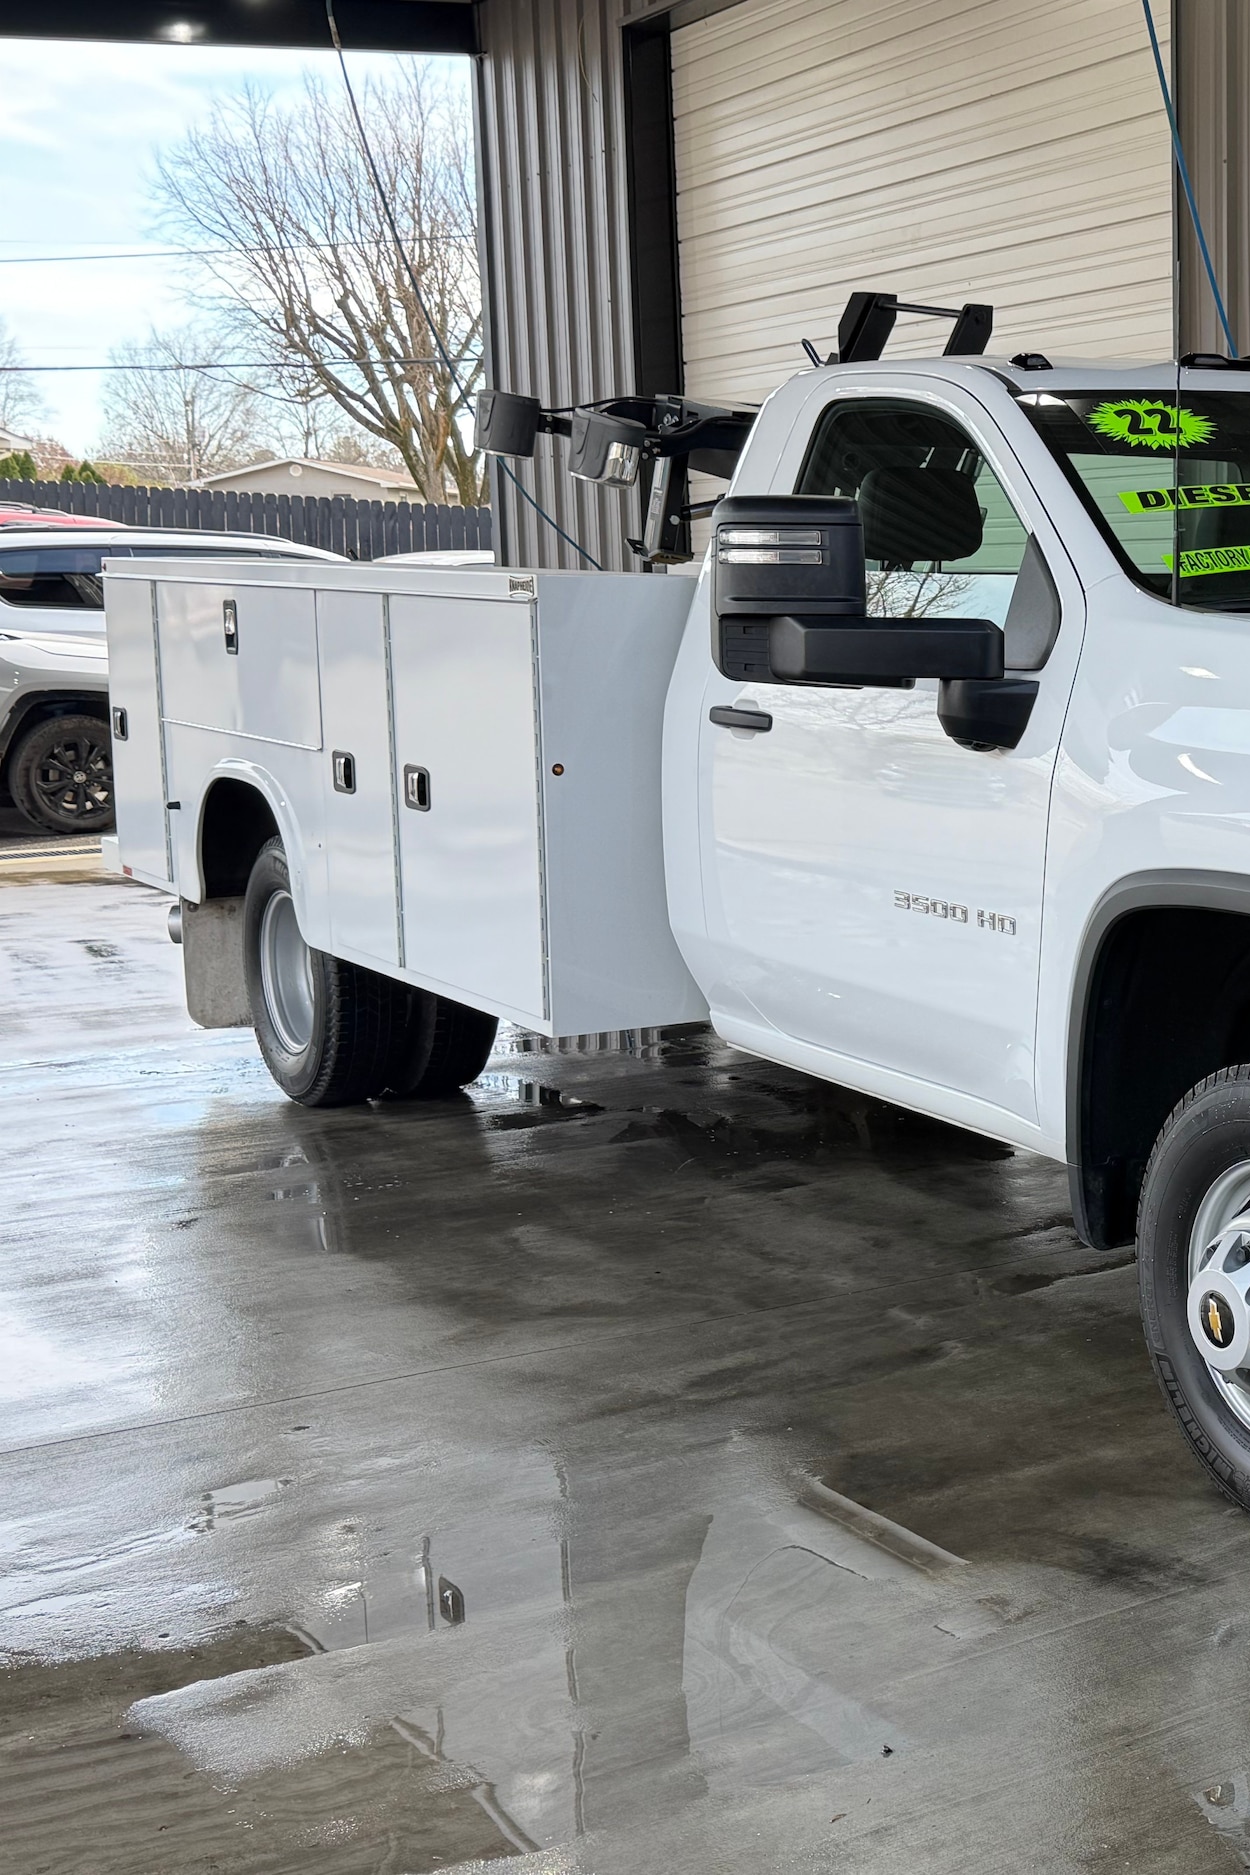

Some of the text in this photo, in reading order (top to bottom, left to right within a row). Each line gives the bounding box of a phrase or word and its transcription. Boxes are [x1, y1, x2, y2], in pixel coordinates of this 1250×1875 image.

[1113, 408, 1183, 435] 22
[894, 889, 1016, 935] 3500 HD
[1159, 1360, 1232, 1481] MICHELIN
